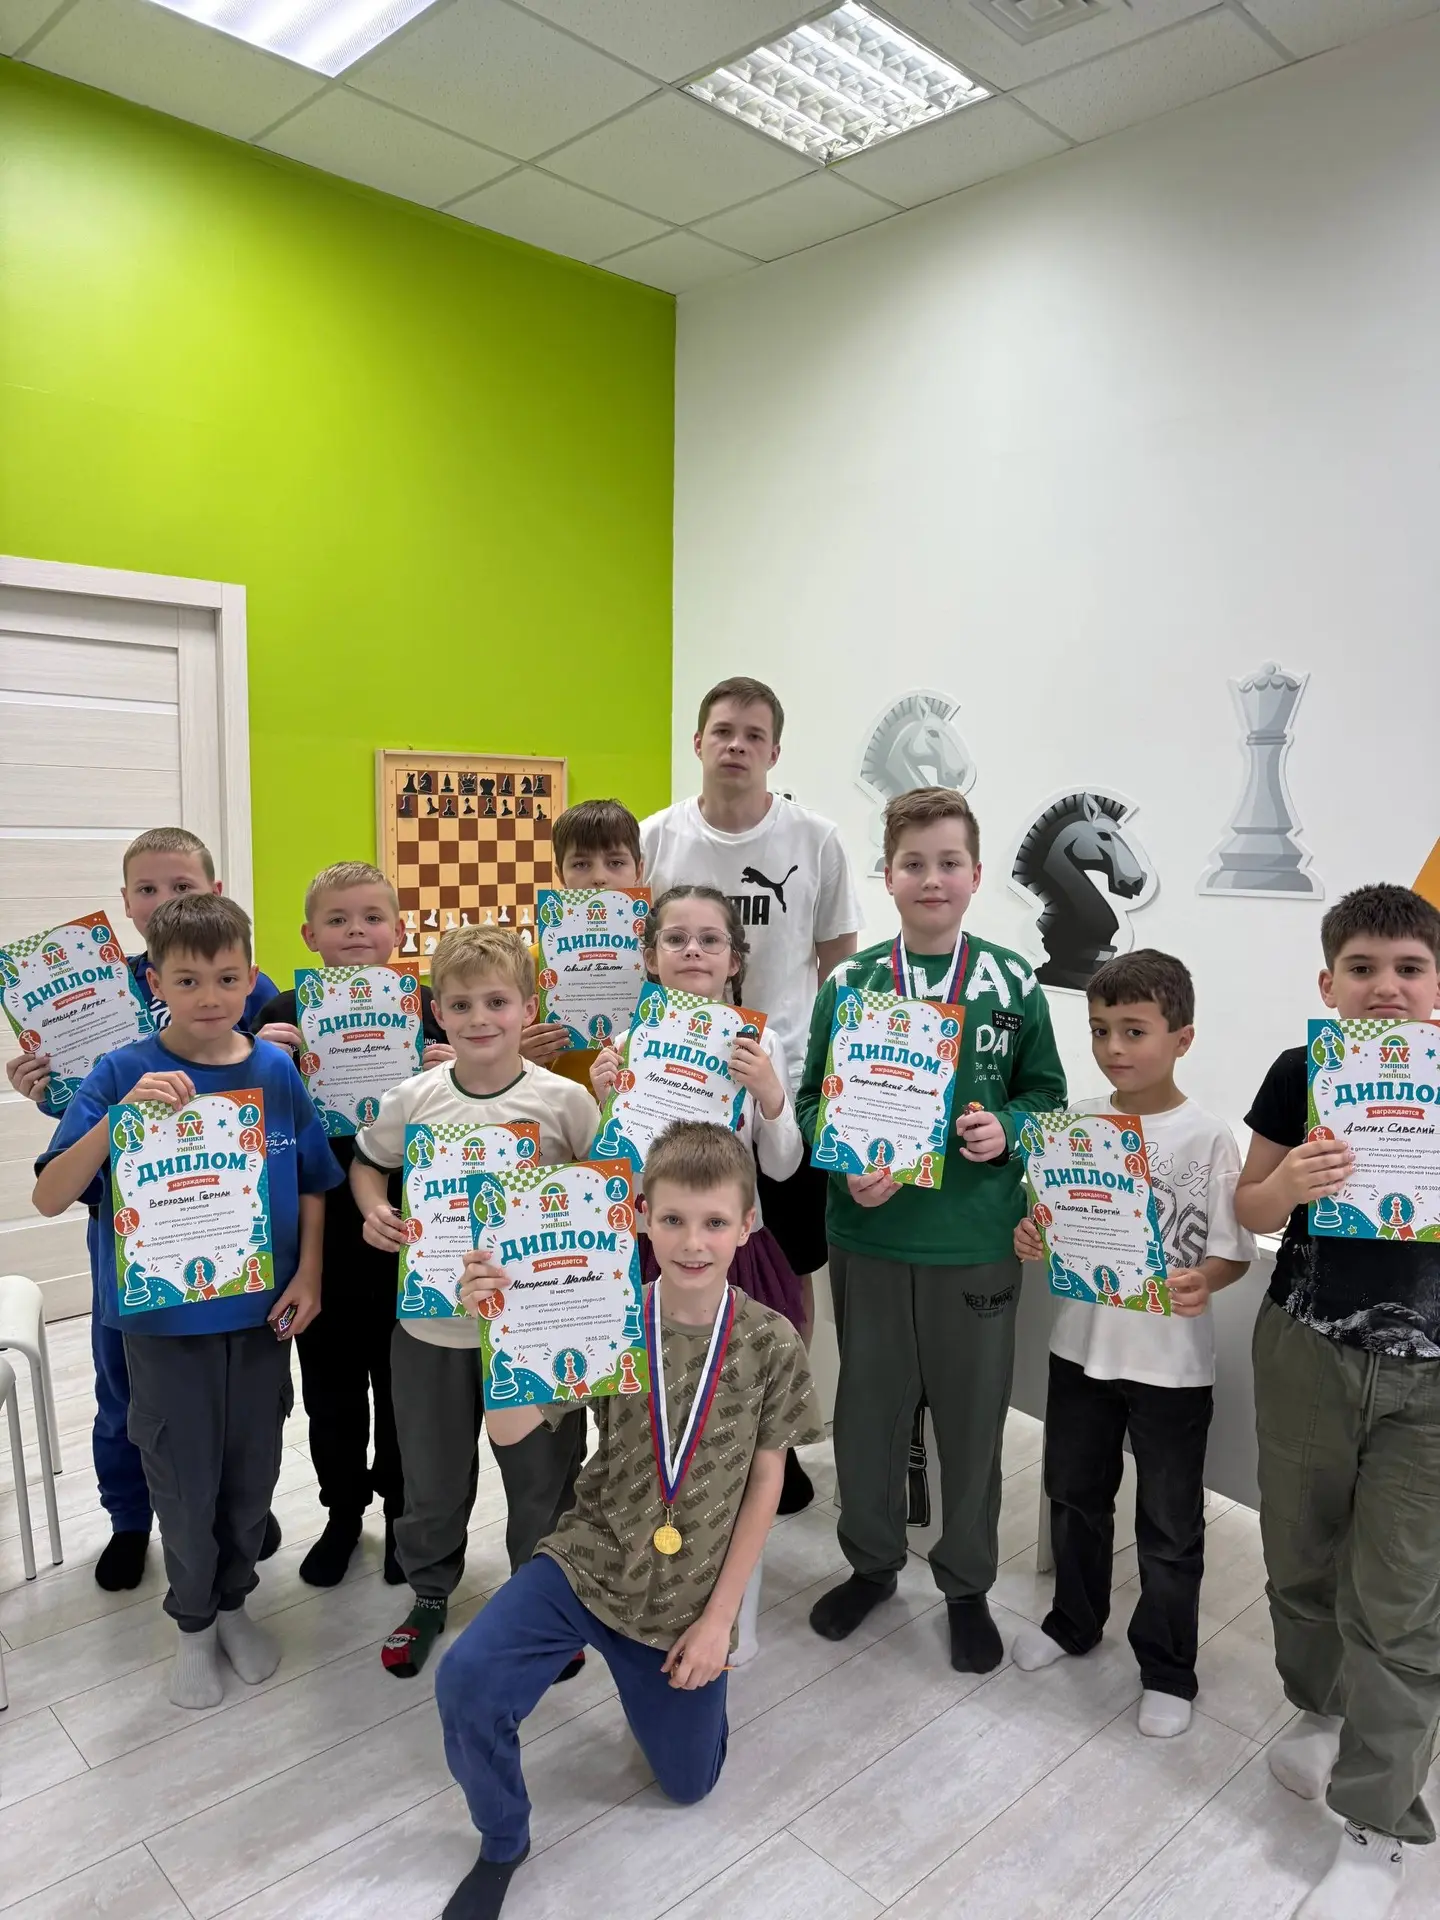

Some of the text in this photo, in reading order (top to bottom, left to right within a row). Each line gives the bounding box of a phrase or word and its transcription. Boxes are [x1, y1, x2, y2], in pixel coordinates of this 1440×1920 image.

[726, 896, 770, 925] MA
[557, 934, 639, 954] ДИПЛОМ
[22, 965, 114, 1012] ДИПЛОМ
[318, 1012, 408, 1036] ДИПЛОМ
[848, 1043, 941, 1074] ДИПЛОМ
[669, 1066, 704, 1079] награждается
[874, 1067, 910, 1076] награждается
[645, 1072, 714, 1098] Марухно Валерия
[1334, 1082, 1440, 1107] ДИПЛО
[1344, 1122, 1435, 1135] Долгих Савелий
[137, 1152, 247, 1187] ДИПЛОМ
[172, 1177, 215, 1188] награждается
[424, 1177, 468, 1201] ДИП
[1043, 1168, 1134, 1194] ДИПЛОМ
[150, 1190, 230, 1208] Верхозин Герман
[431, 1213, 465, 1224] Жгунов
[1091, 1205, 1120, 1215] Георгий
[541, 1221, 572, 1229] УМНИЦЫ
[500, 1230, 617, 1266] ДИПЛОМ
[538, 1259, 583, 1268] награждается
[562, 1271, 604, 1285] Матвей
[724, 1450, 748, 1471] DKNY
